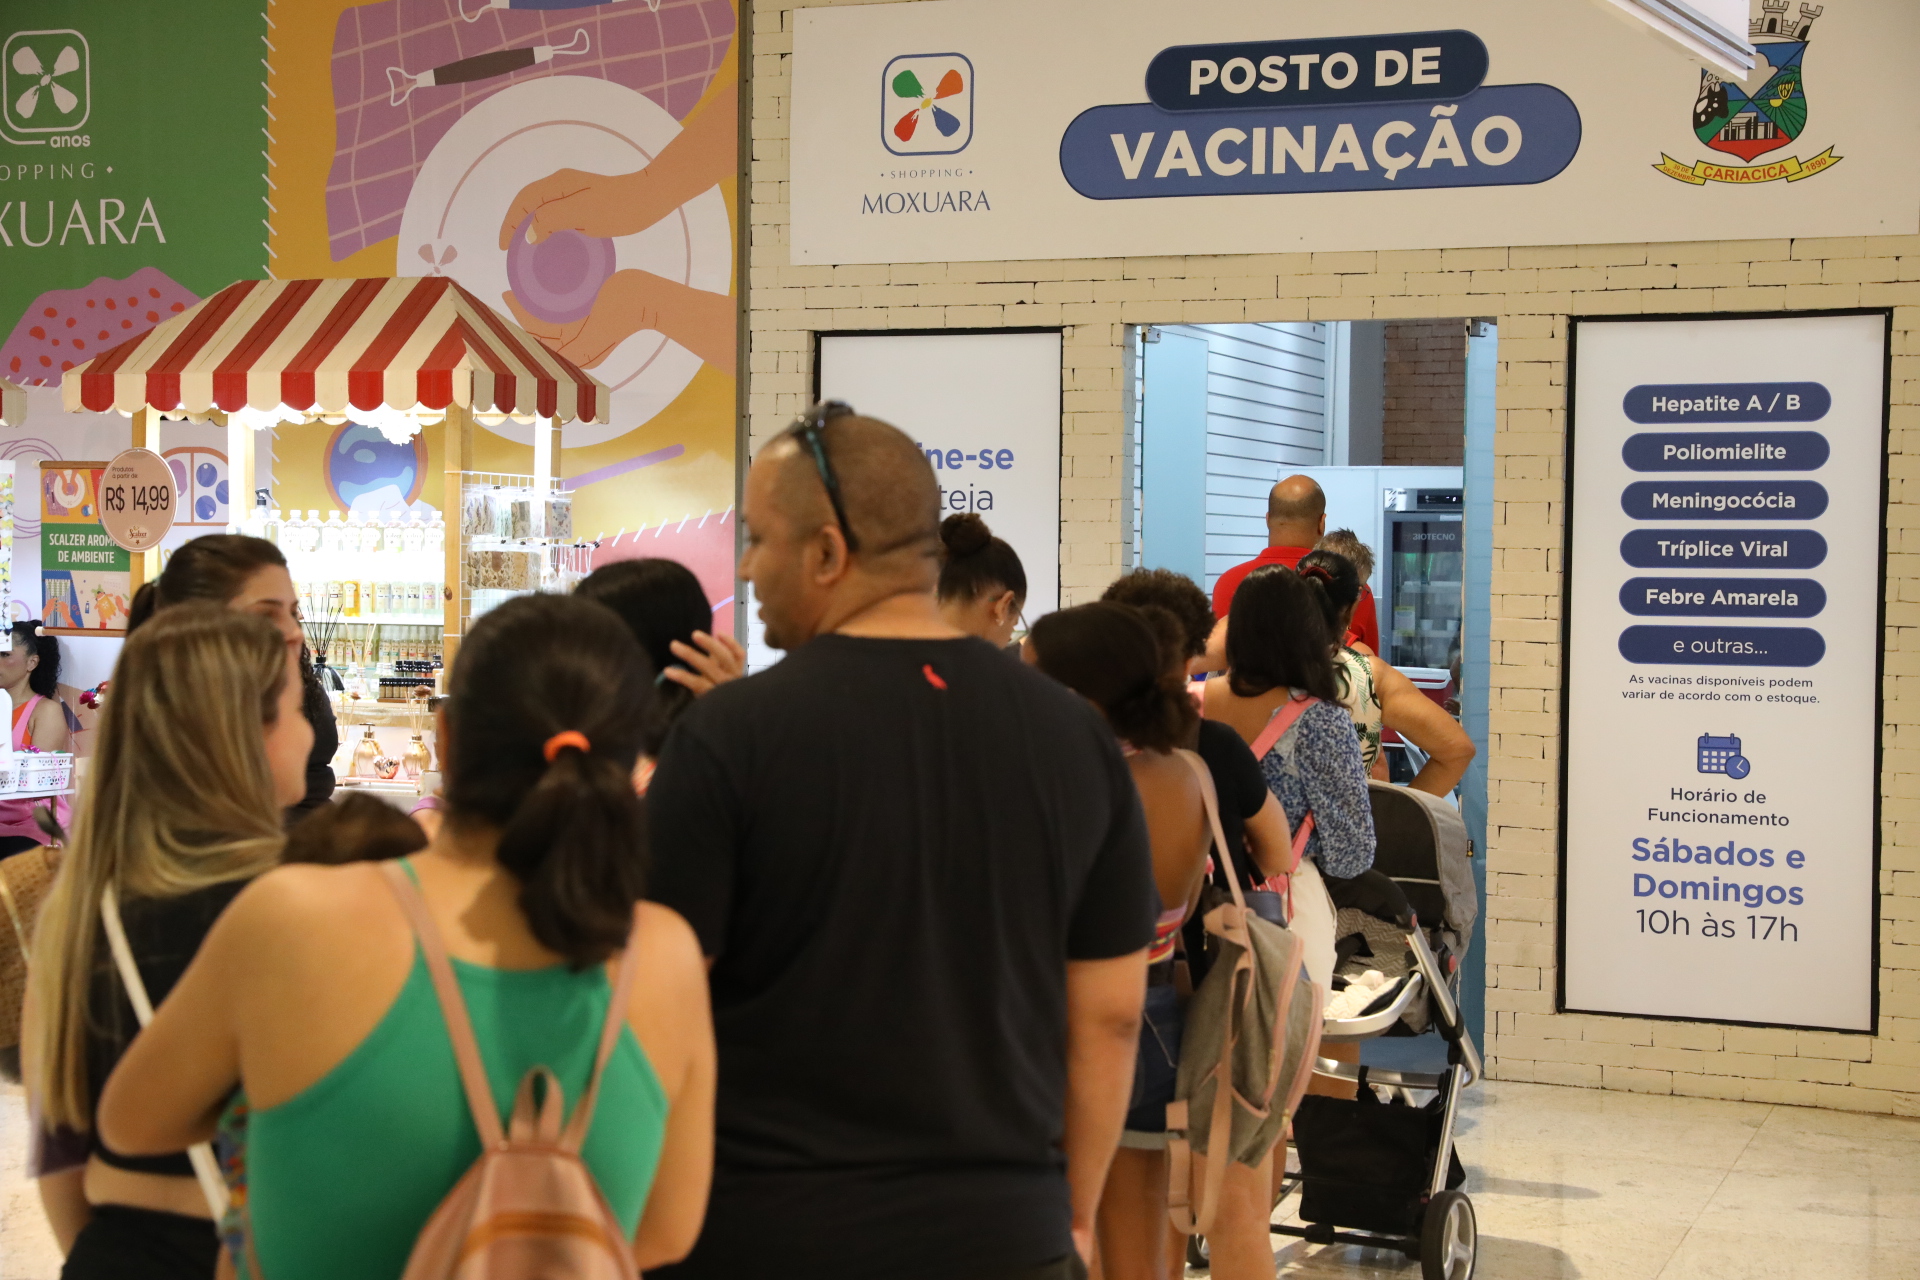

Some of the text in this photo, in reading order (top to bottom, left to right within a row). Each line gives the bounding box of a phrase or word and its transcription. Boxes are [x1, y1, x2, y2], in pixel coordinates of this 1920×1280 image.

[1189, 47, 1441, 95] POSTO DE
[50, 135, 91, 148] anos
[1110, 104, 1523, 181] VACINAÇÃO
[890, 168, 963, 179] SHOPPING
[1663, 166, 1696, 182] DEZEMBRO
[1703, 164, 1789, 181] CARIACICA
[1805, 158, 1827, 173] 1890
[862, 190, 991, 214] MOXUARA
[1652, 393, 1801, 415] Hepatite A / B
[1663, 443, 1787, 460] Poliomielite
[105, 485, 169, 515] R$ 14,99
[1652, 492, 1796, 512] Meningocócia
[50, 533, 85, 546] SCALZER
[57, 551, 115, 563] DE AMBIENTE
[1658, 540, 1788, 560] Tríplice Viral
[1646, 589, 1798, 606] Febre Amarela
[1673, 638, 1768, 655] e outras...
[1629, 674, 1813, 688] As vacinas disponíveis podem
[1622, 690, 1820, 705] variar de acordo com o estoque.
[1671, 787, 1767, 804] Horário de
[1648, 808, 1790, 827] Funcionamento
[1632, 836, 1806, 869] Sábados e
[1633, 873, 1804, 908] Domingos
[1636, 909, 1798, 942] 10h às 17h
